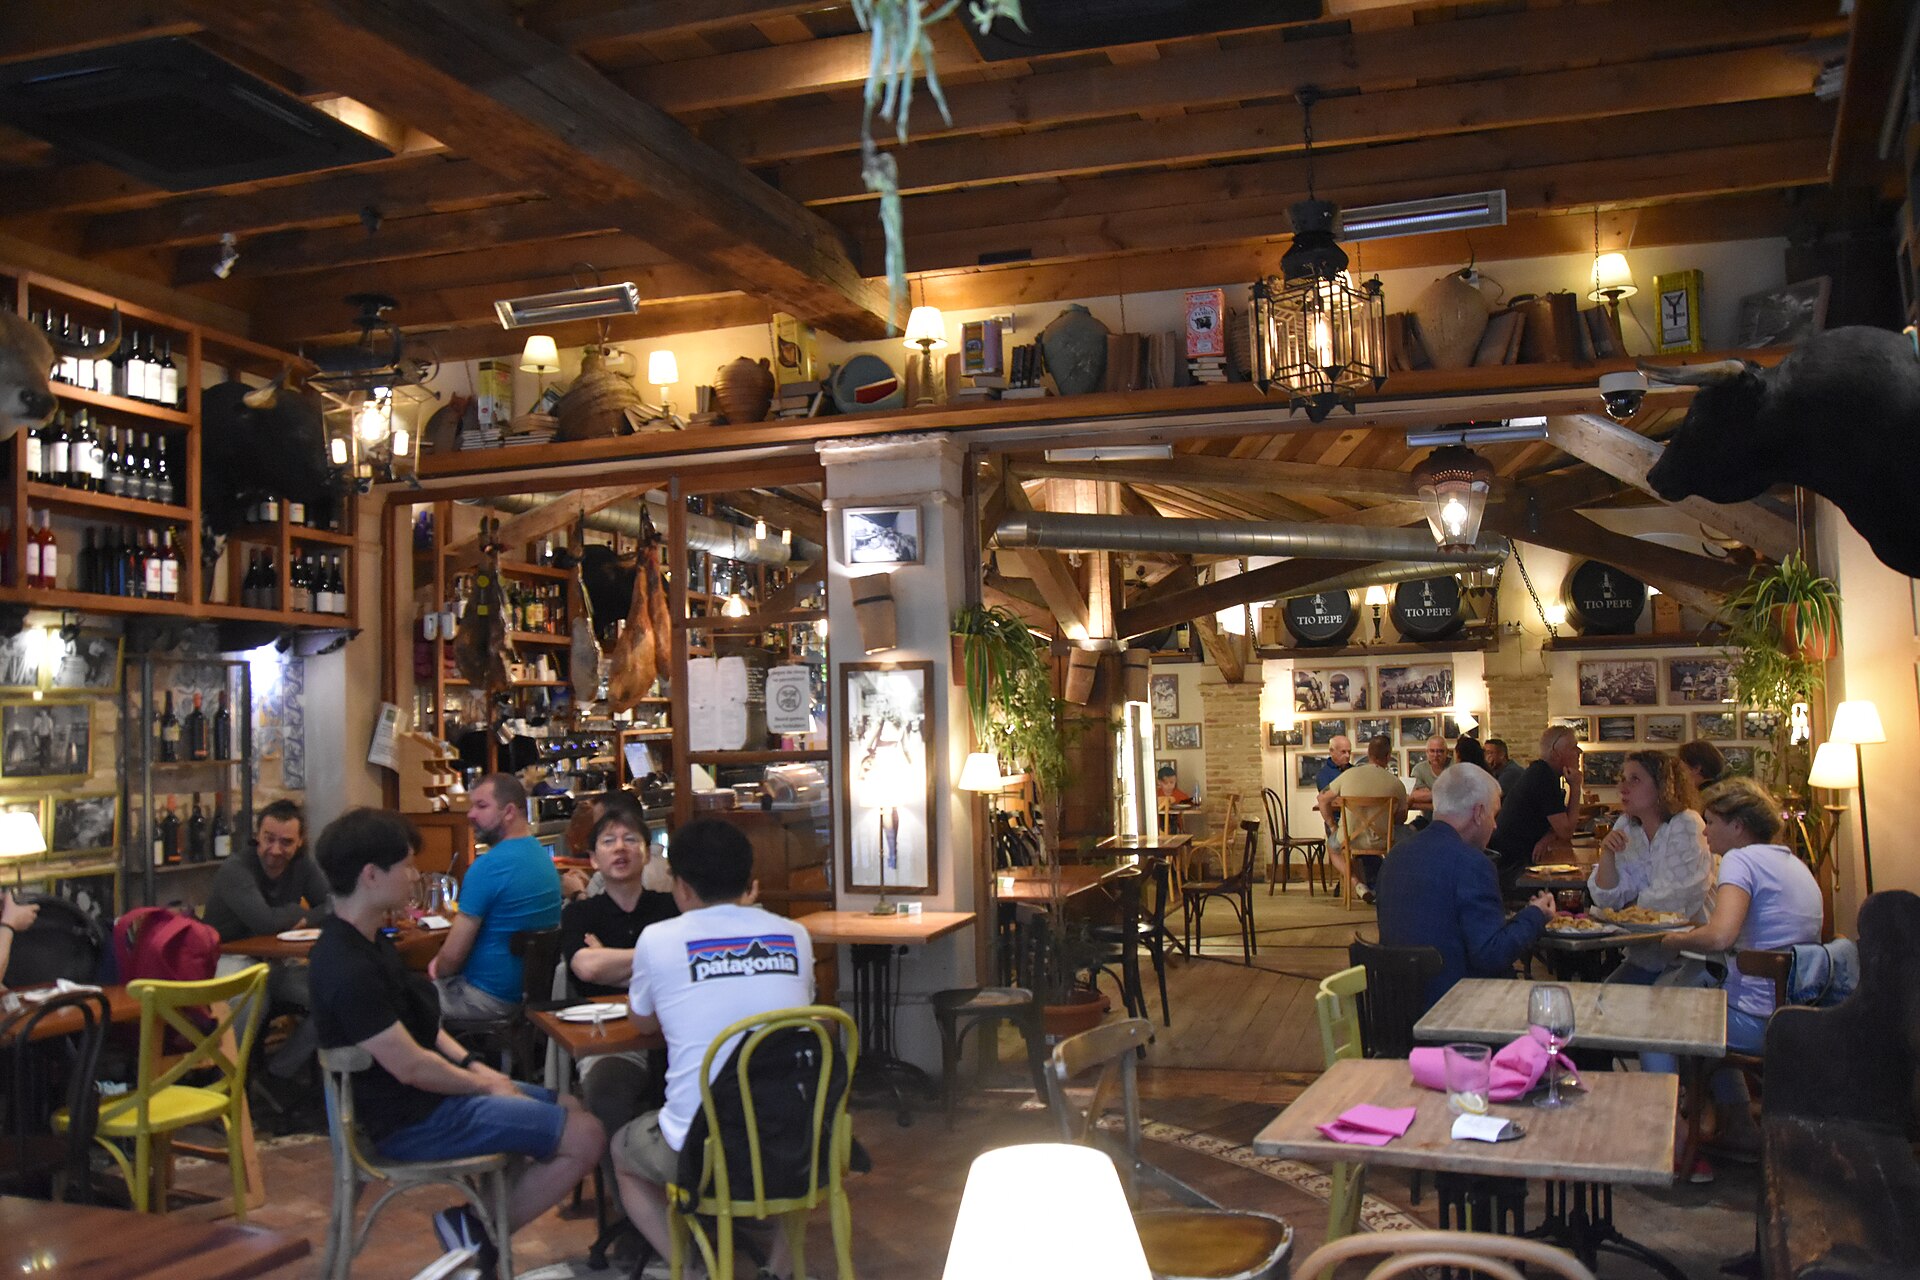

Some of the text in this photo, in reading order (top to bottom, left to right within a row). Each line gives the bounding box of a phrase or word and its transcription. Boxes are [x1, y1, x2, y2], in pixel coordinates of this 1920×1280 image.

[1583, 599, 1632, 609] TIO PEPE
[1405, 607, 1451, 617] TIO PEPE
[1297, 615, 1343, 625] TIO PEPE
[695, 954, 795, 981] patagonia
